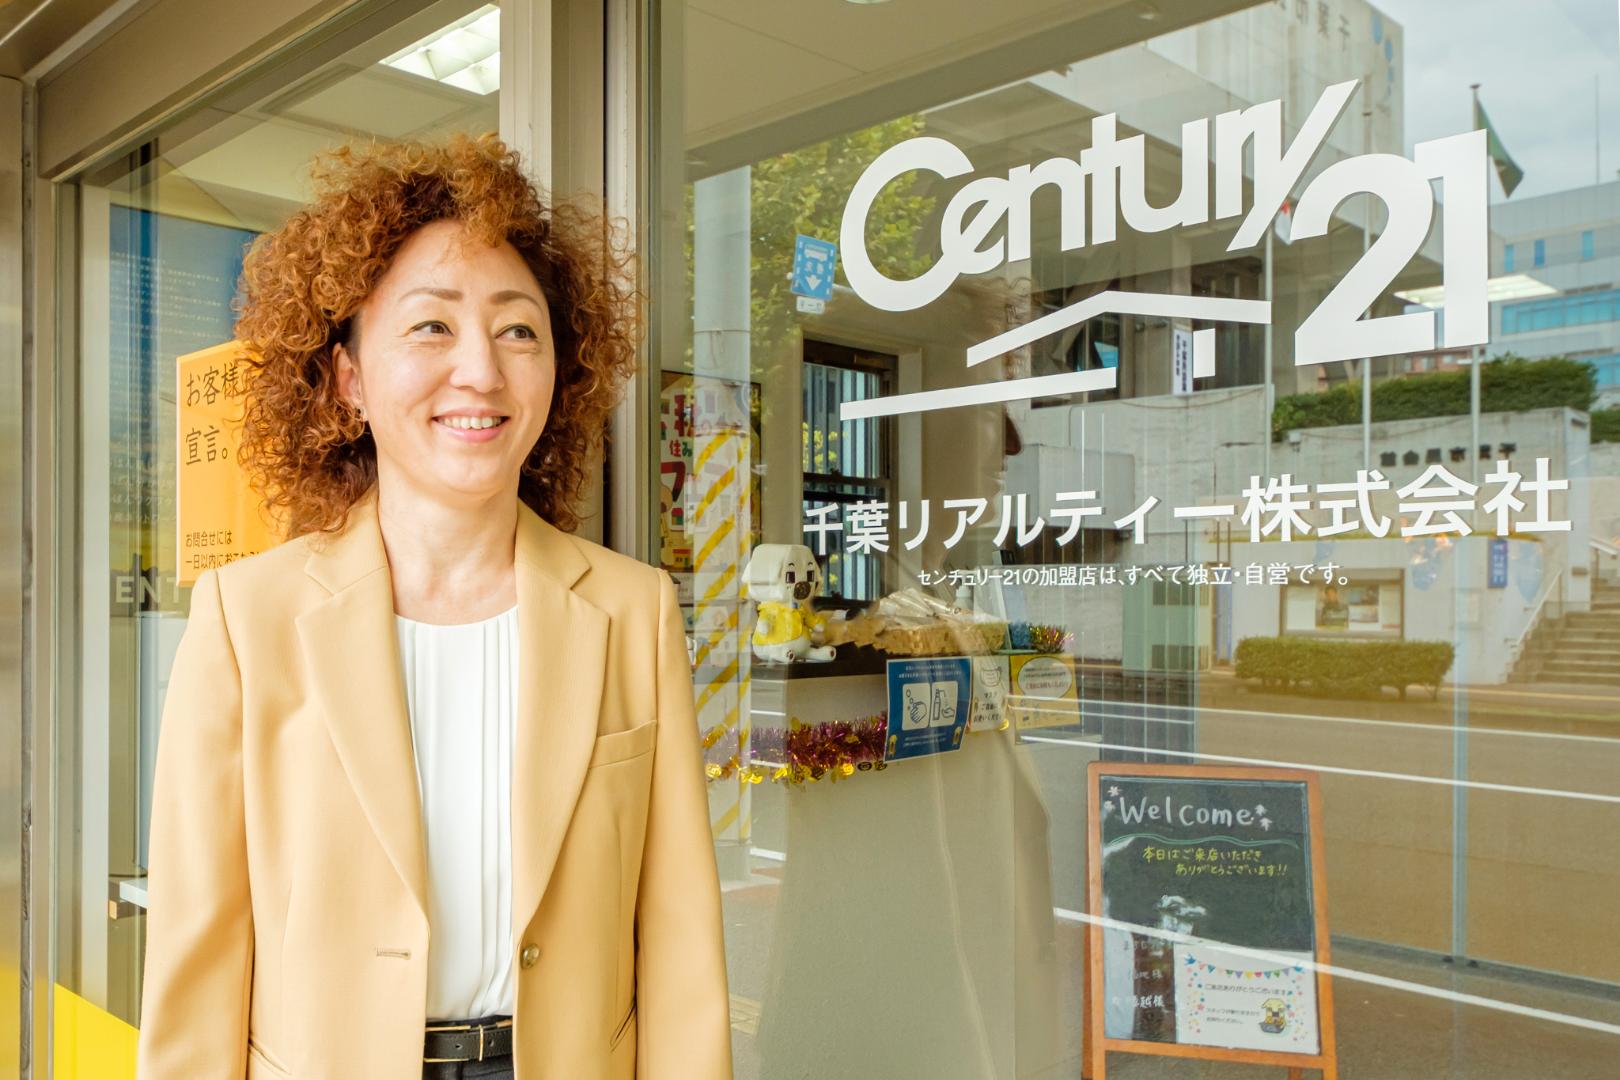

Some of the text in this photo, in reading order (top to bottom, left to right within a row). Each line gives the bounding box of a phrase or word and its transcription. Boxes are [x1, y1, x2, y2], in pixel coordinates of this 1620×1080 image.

[1290, 129, 1490, 366] 21
[186, 425, 228, 465] 宣言。
[803, 457, 1573, 555] 千葉リアルティー株式会社
[185, 530, 233, 548] お問合せには
[1119, 796, 1254, 828] Welcome
[1143, 846, 1264, 863] 本日はご来店いただき
